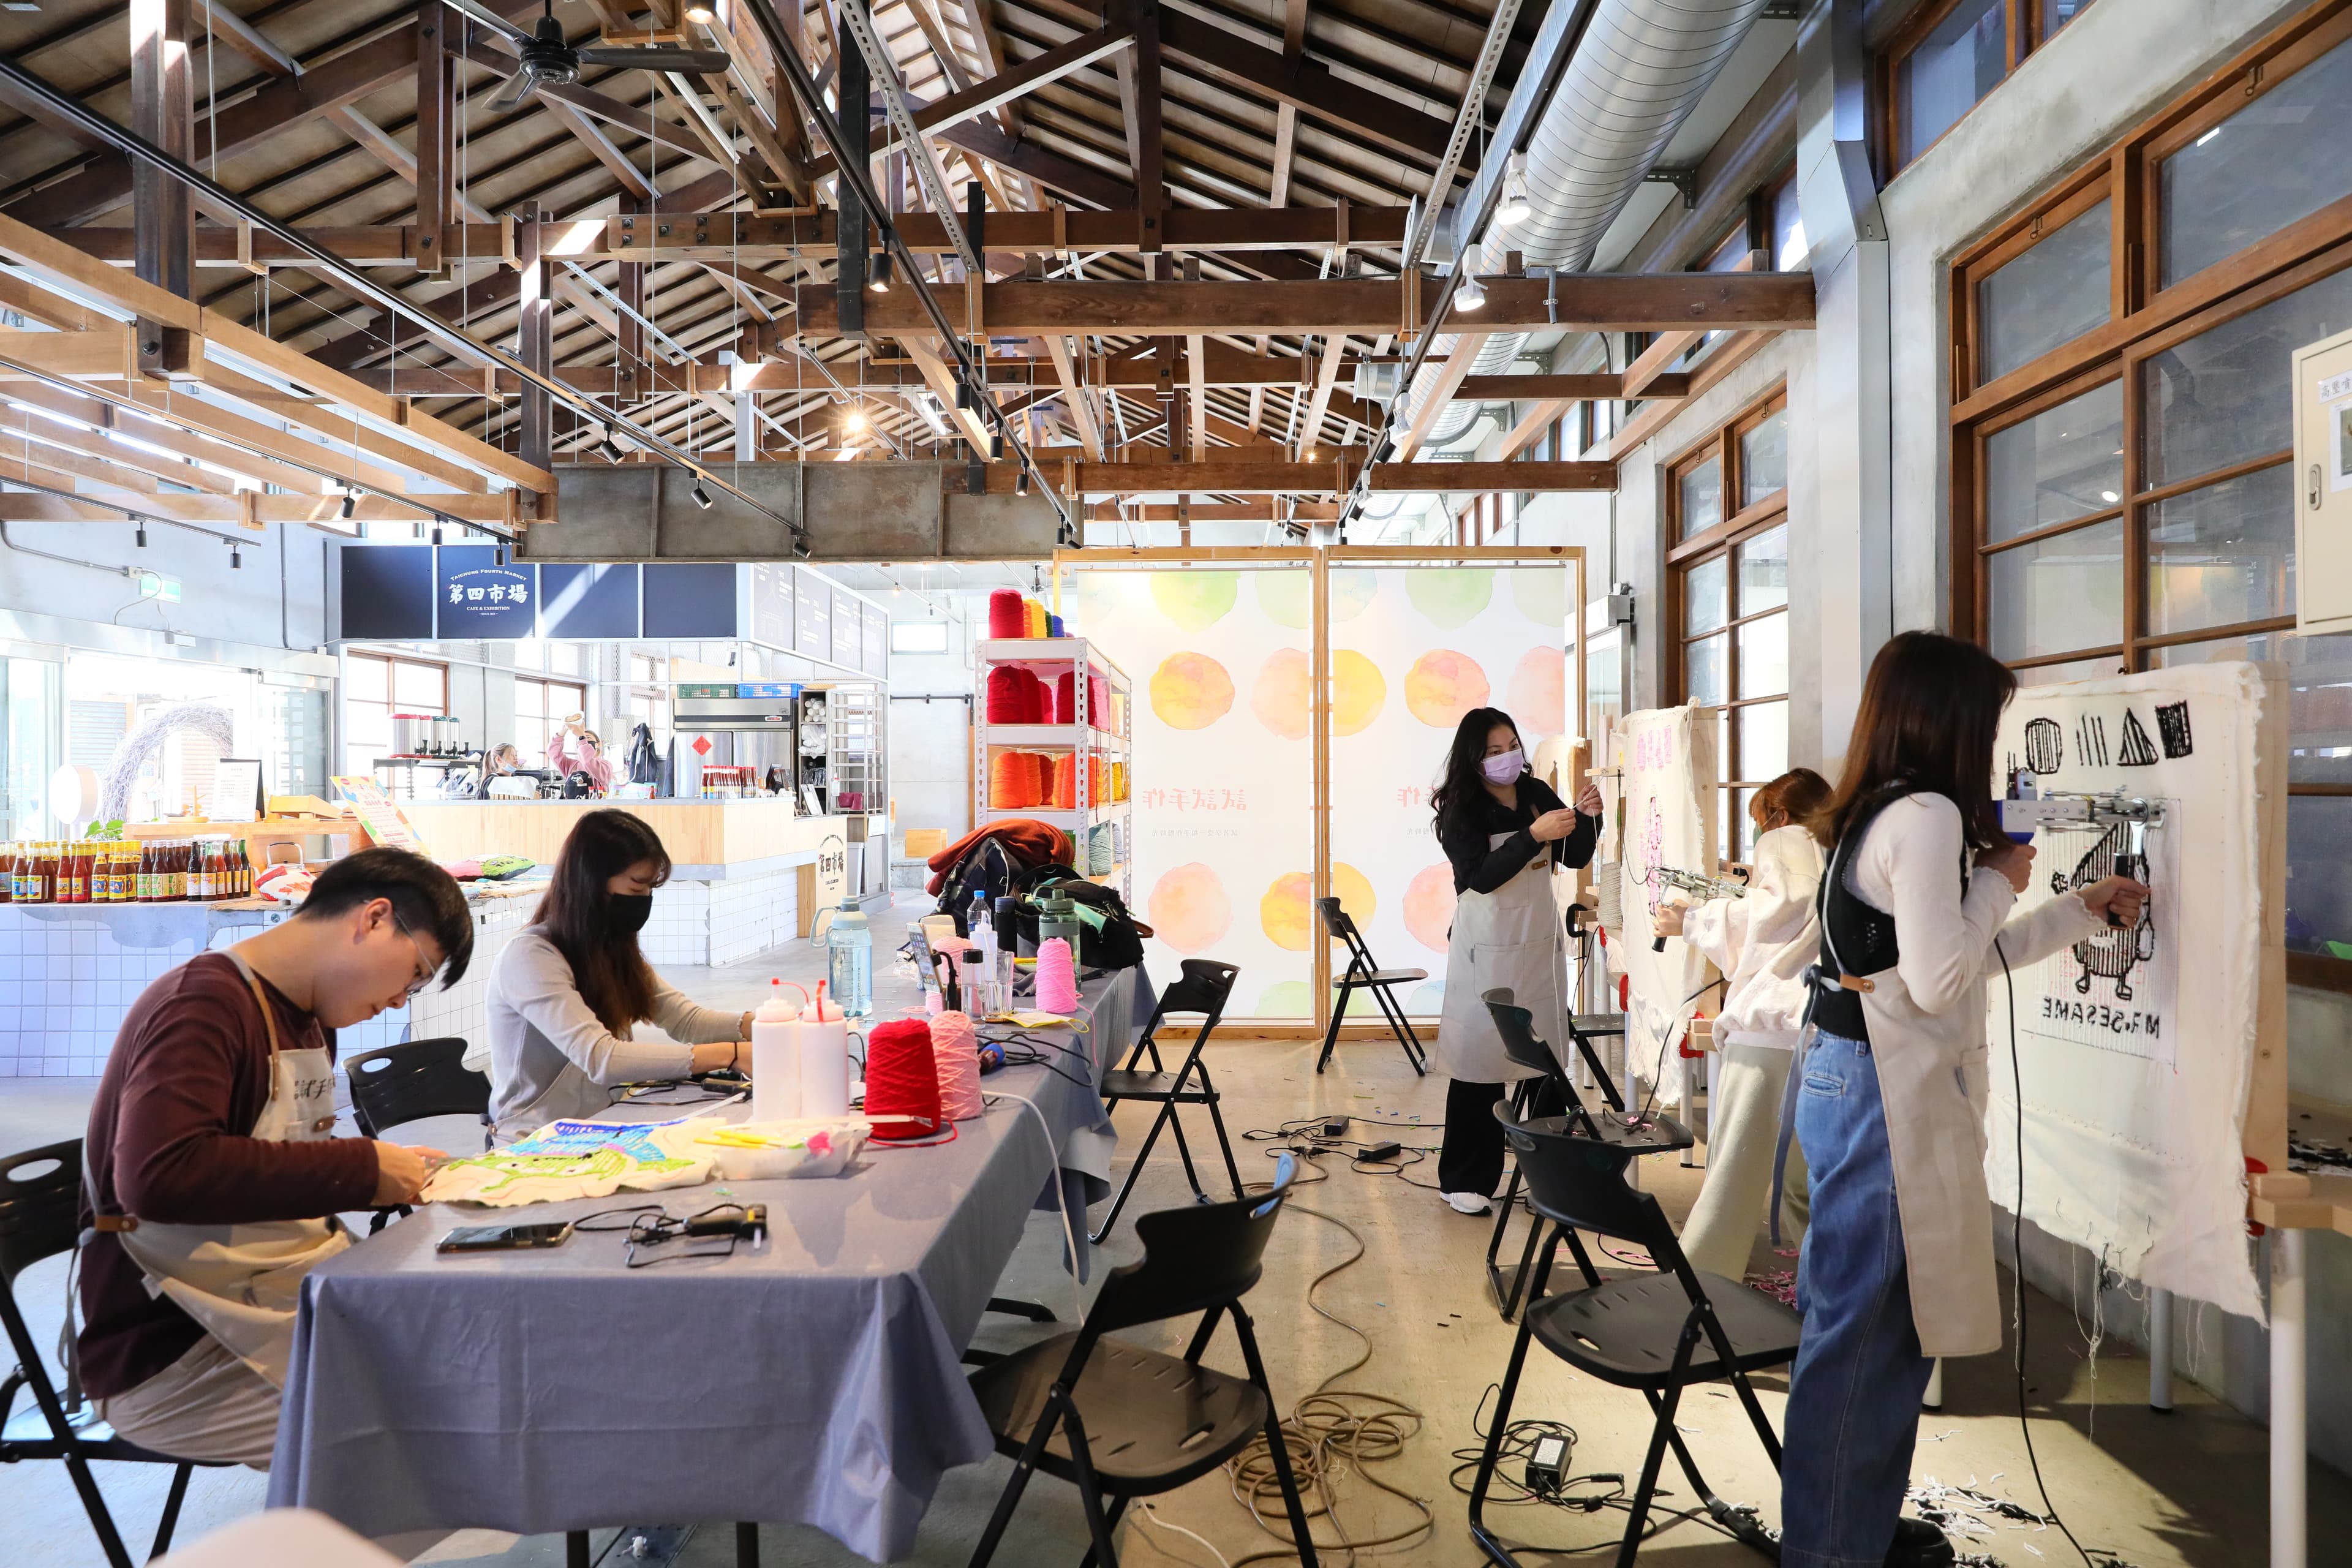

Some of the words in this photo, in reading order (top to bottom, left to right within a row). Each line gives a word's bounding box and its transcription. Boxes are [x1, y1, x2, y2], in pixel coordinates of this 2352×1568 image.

[450, 570, 479, 581] TAICHUNG
[504, 570, 527, 581] MARKET
[449, 584, 528, 604] 第四市場
